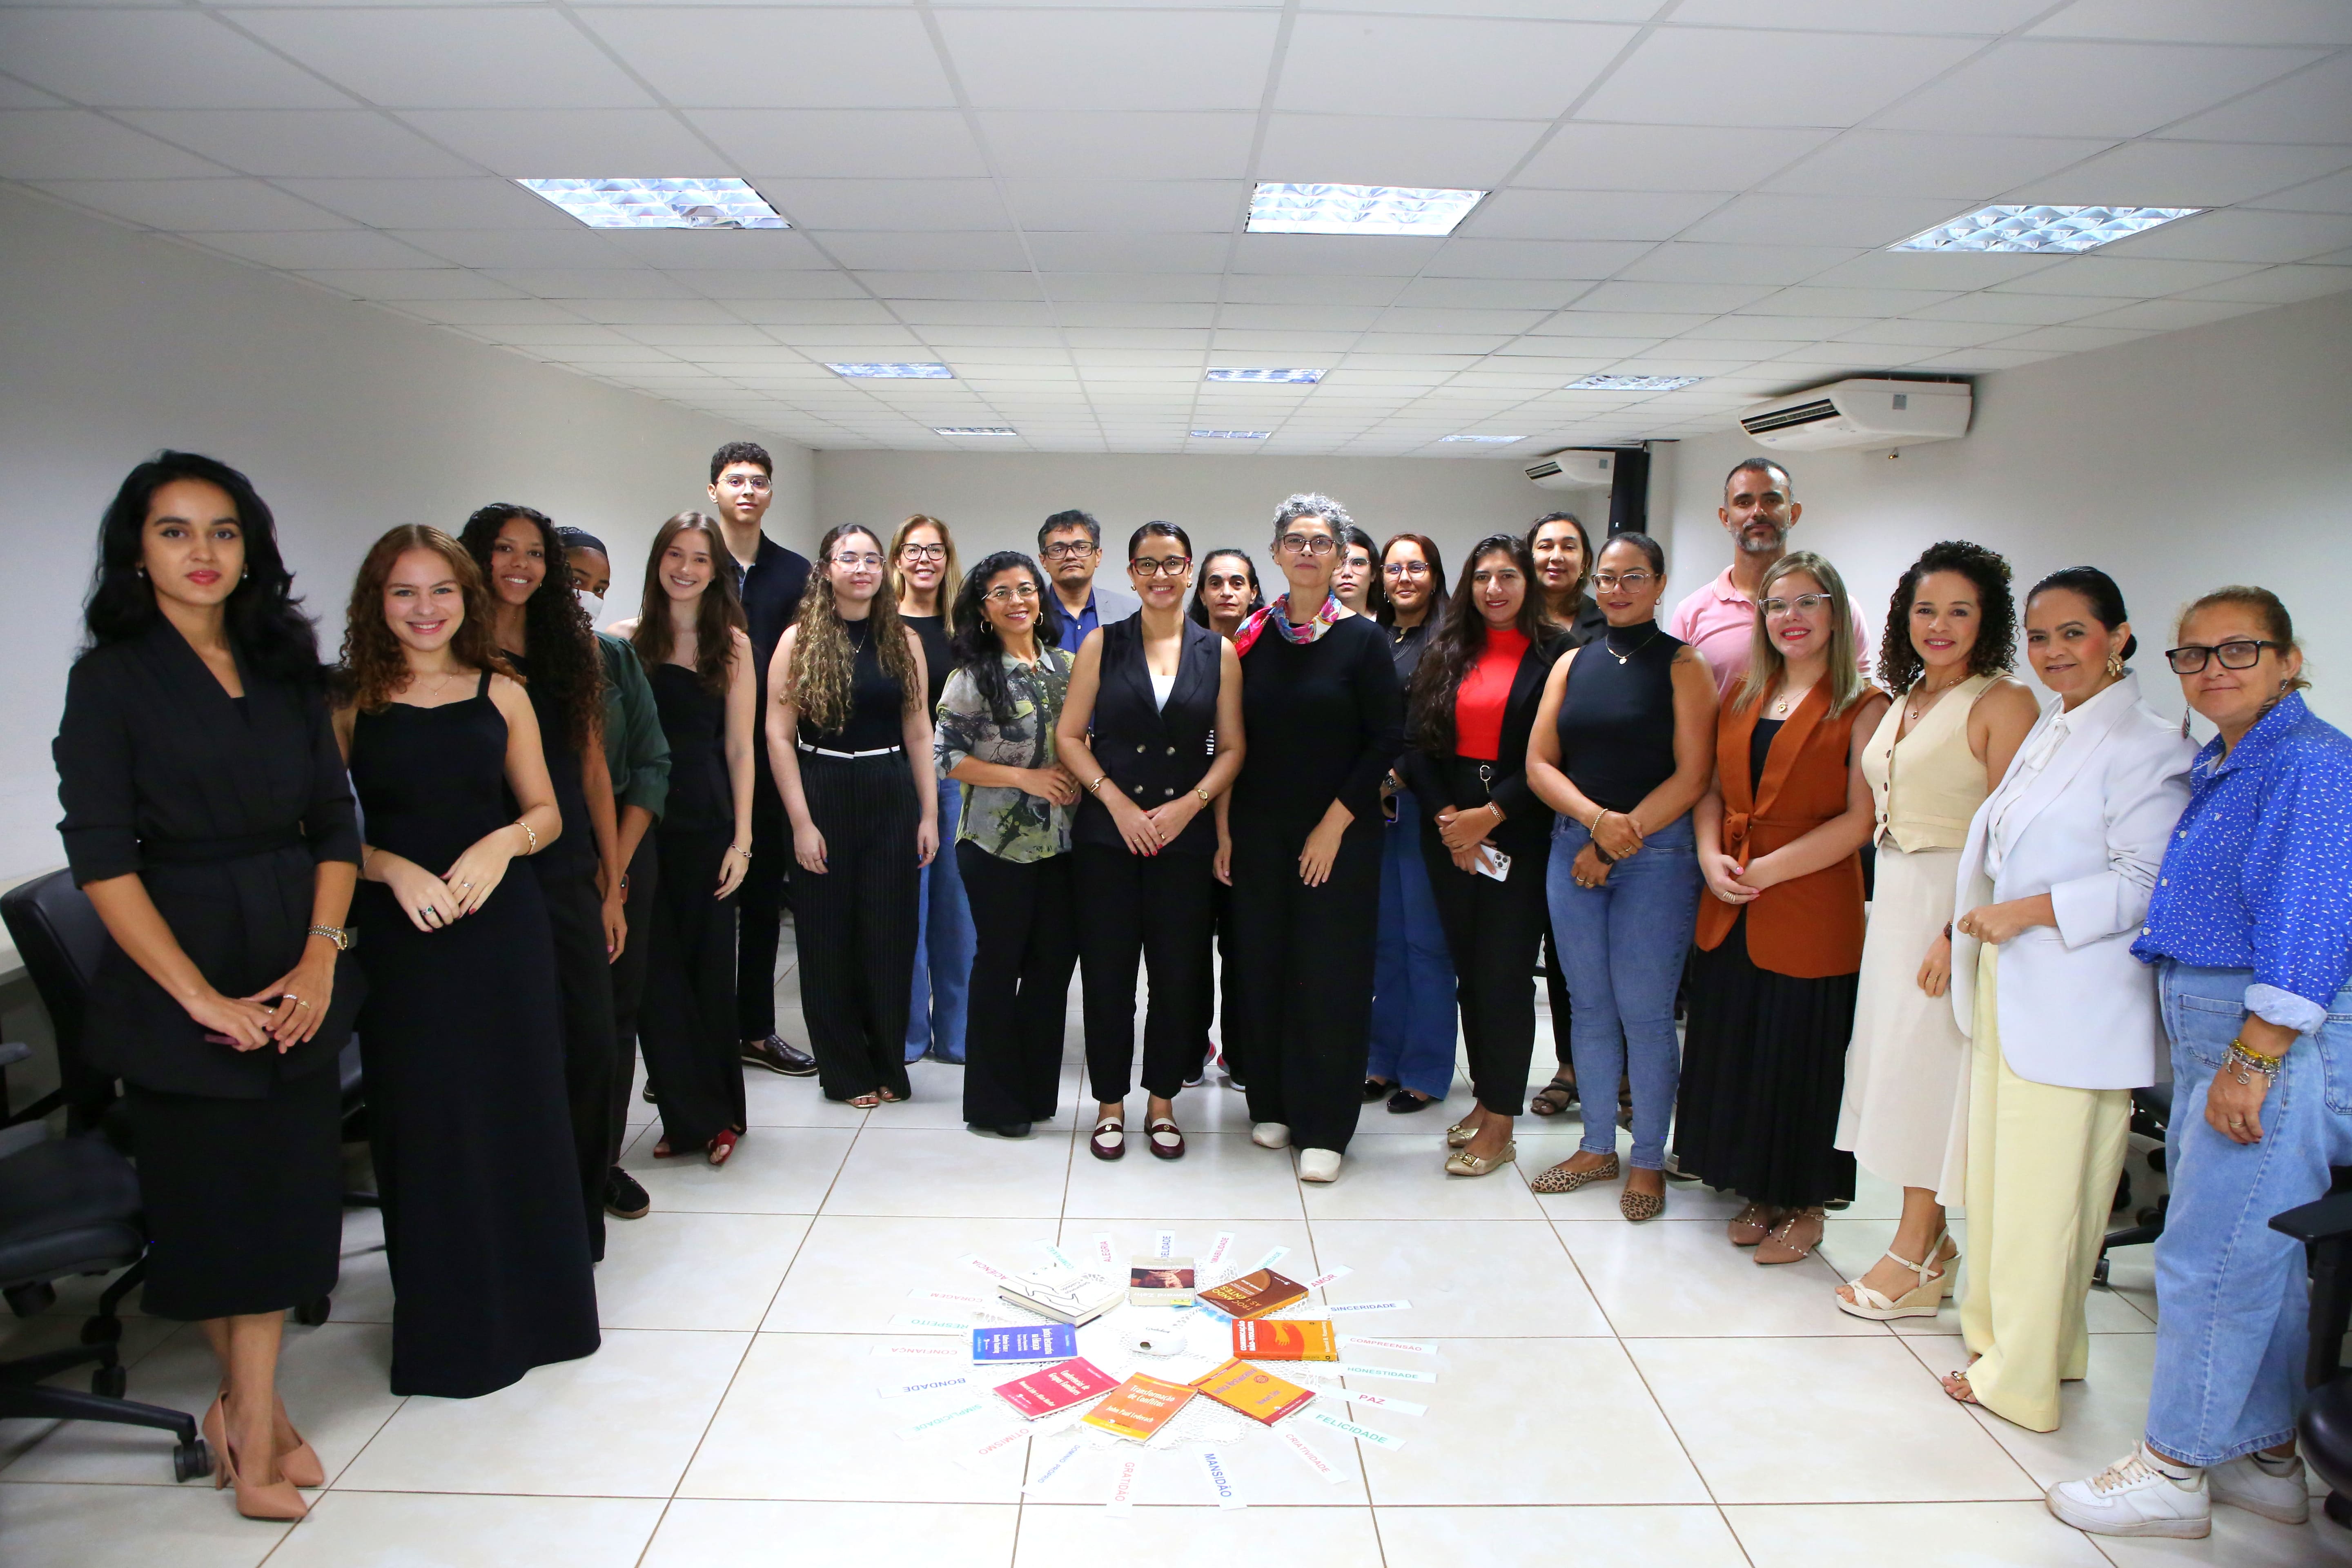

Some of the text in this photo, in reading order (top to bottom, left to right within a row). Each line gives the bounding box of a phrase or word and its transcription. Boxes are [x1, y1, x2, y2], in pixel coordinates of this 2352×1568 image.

[1100, 1241, 1111, 1262] ALEGRIA
[1161, 1236, 1171, 1257] DELIDADE
[1047, 1246, 1074, 1269] COMPAIXÃO
[974, 1261, 1008, 1279] ACIÊNCIA
[1311, 1274, 1337, 1288] AMOR
[931, 1293, 982, 1302] CORAGEM
[1209, 1287, 1253, 1310] TROCANDO
[1220, 1286, 1250, 1301] LENTES
[911, 1320, 968, 1329] RESPEITO
[1237, 1321, 1248, 1351] COMUNICAÇÃO
[1246, 1321, 1256, 1351] NÃO-VIOLENTA
[1350, 1338, 1421, 1351] COMPREENSÃO
[1348, 1368, 1418, 1379] HONESTIDADE
[903, 1378, 966, 1392] BONDADE
[1130, 1385, 1175, 1401] Transformação
[1137, 1395, 1165, 1407] Conflitos
[1359, 1395, 1385, 1405] PAZ
[915, 1405, 982, 1431] SIMPLICIDADE
[1130, 1412, 1153, 1423] Lederach
[1316, 1414, 1388, 1443] FELICIDADE
[979, 1429, 1029, 1454] OTIMISMO
[1286, 1434, 1330, 1472] CRIATIVIDADE
[1115, 1462, 1134, 1501] GRATIDÃO
[1204, 1454, 1232, 1497] MANSIDÃO
